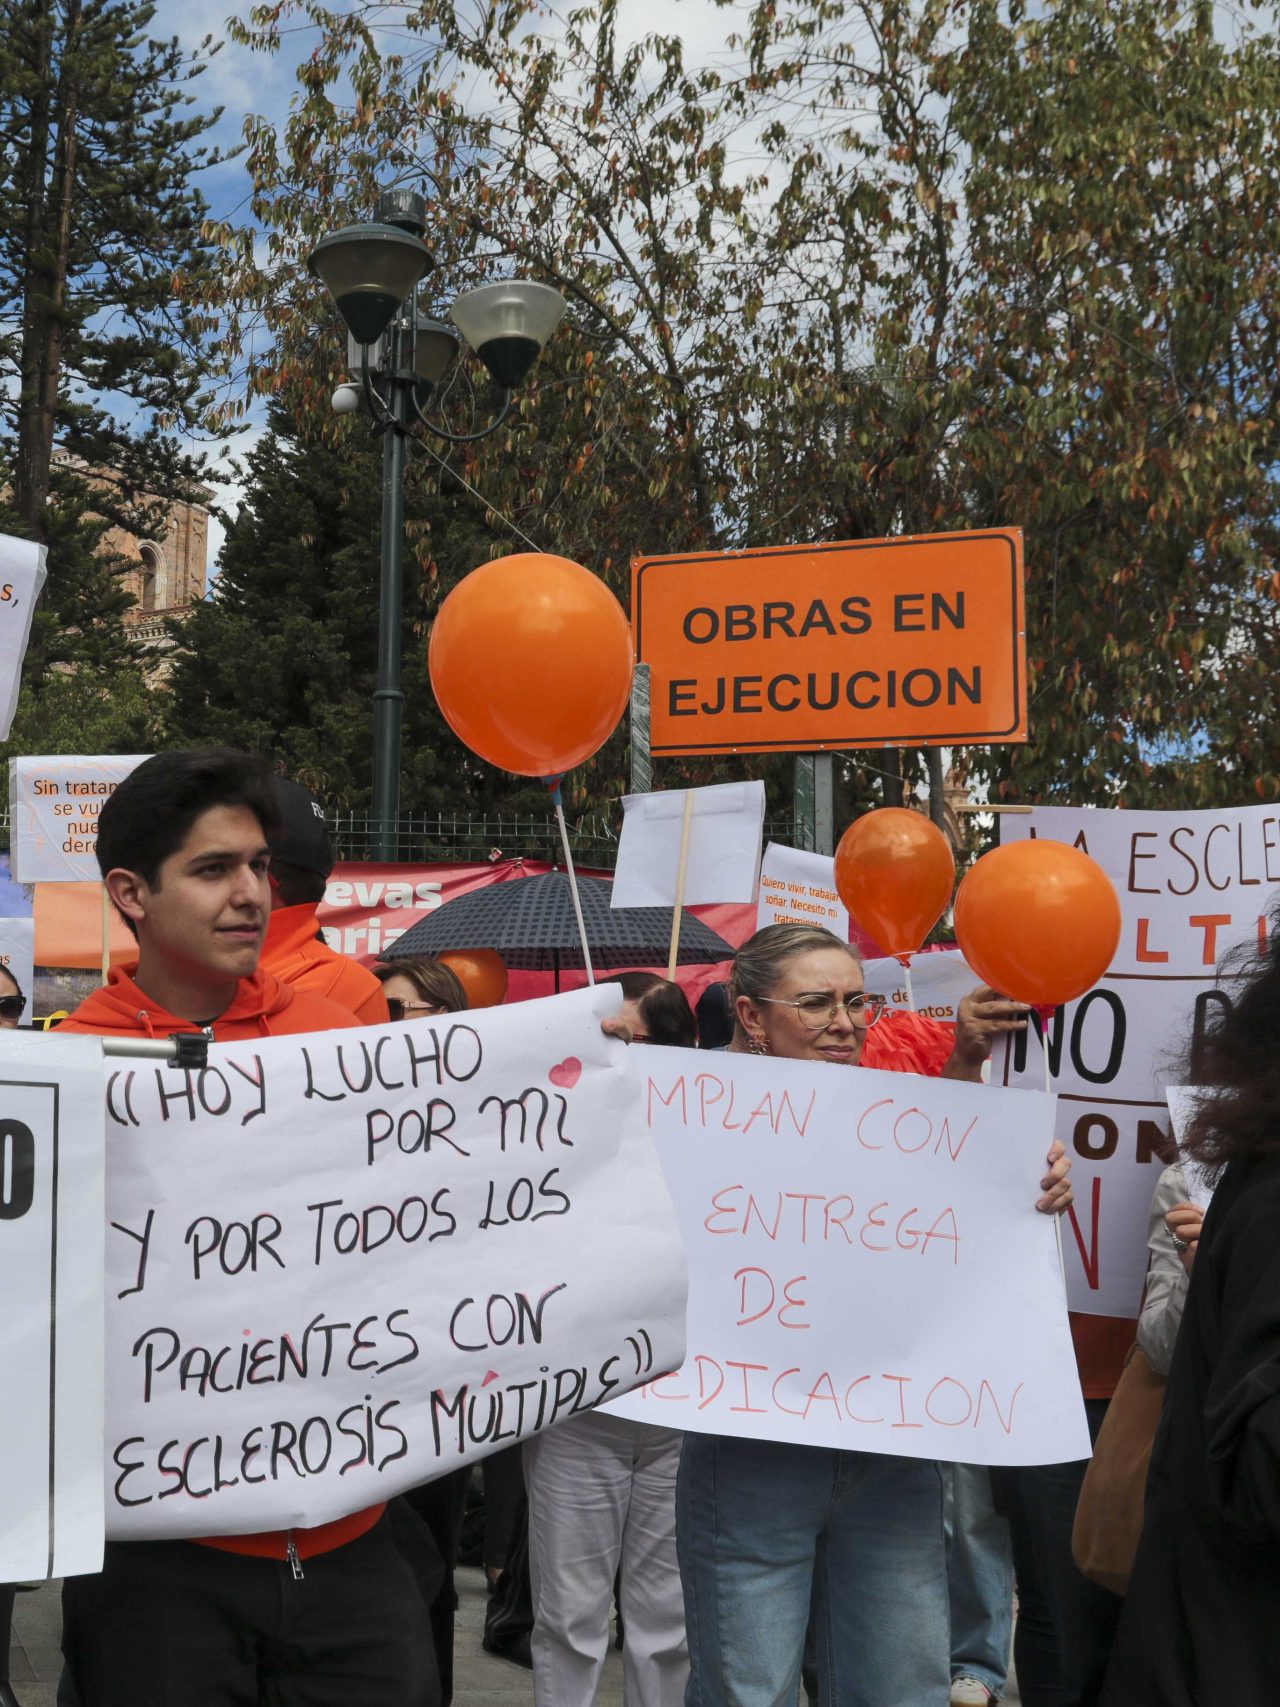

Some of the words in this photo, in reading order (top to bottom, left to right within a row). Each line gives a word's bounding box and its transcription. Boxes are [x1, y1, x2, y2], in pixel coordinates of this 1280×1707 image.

[682, 596, 873, 645] OBRAS
[894, 591, 965, 632] EN
[668, 665, 982, 717] EJECUCION
[33, 780, 59, 795] Sin
[54, 803, 72, 815] se
[762, 875, 785, 890] Quiero
[788, 881, 807, 896] vivir,
[791, 898, 826, 916] Necesito
[828, 908, 838, 918] mi
[303, 1024, 483, 1101] LUCHO
[367, 1098, 470, 1166] POR
[857, 1098, 979, 1162] CON
[111, 1210, 154, 1299] Y
[185, 1212, 286, 1280] POR
[308, 1189, 457, 1266] TODOS
[479, 1168, 571, 1229] LOS
[703, 1185, 962, 1264] ENTREGA
[450, 1282, 567, 1351] CON
[734, 1266, 811, 1329] DE
